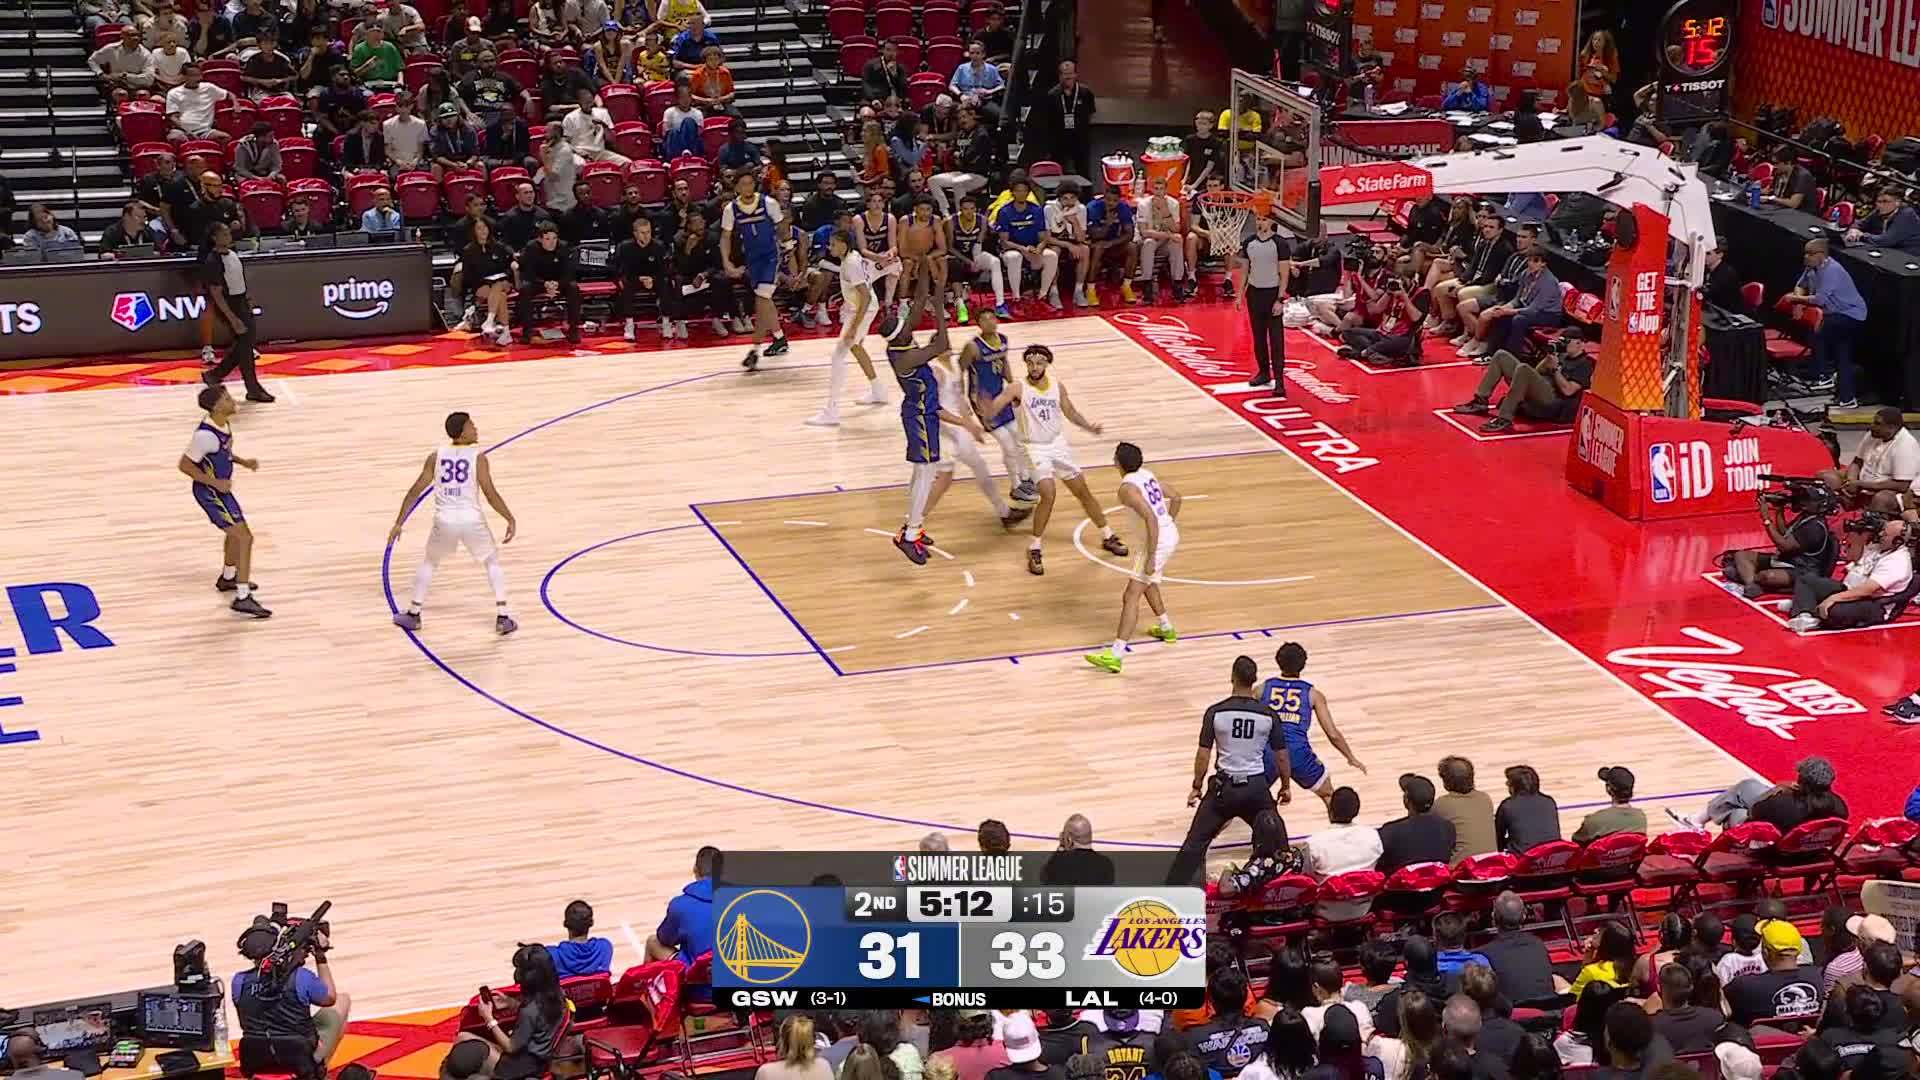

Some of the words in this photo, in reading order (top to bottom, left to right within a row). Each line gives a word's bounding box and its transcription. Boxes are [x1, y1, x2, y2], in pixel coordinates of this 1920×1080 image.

[1687, 39, 1716, 66] 15
[1681, 80, 1725, 92] TISSOT
[323, 277, 394, 307] prime
[1637, 272, 1658, 292] GET
[1635, 291, 1657, 312] THE
[1113, 313, 1251, 377] Michelob
[1039, 408, 1051, 421] 41
[1243, 396, 1381, 474] ULTRA
[1723, 437, 1760, 465] JOIN
[440, 459, 469, 484] 38
[1724, 463, 1773, 492] TODAY
[1605, 632, 1819, 741] Vegas
[1268, 687, 1302, 712] 55
[1232, 718, 1256, 739] 80
[1107, 1047, 1145, 1064] BRYANT
